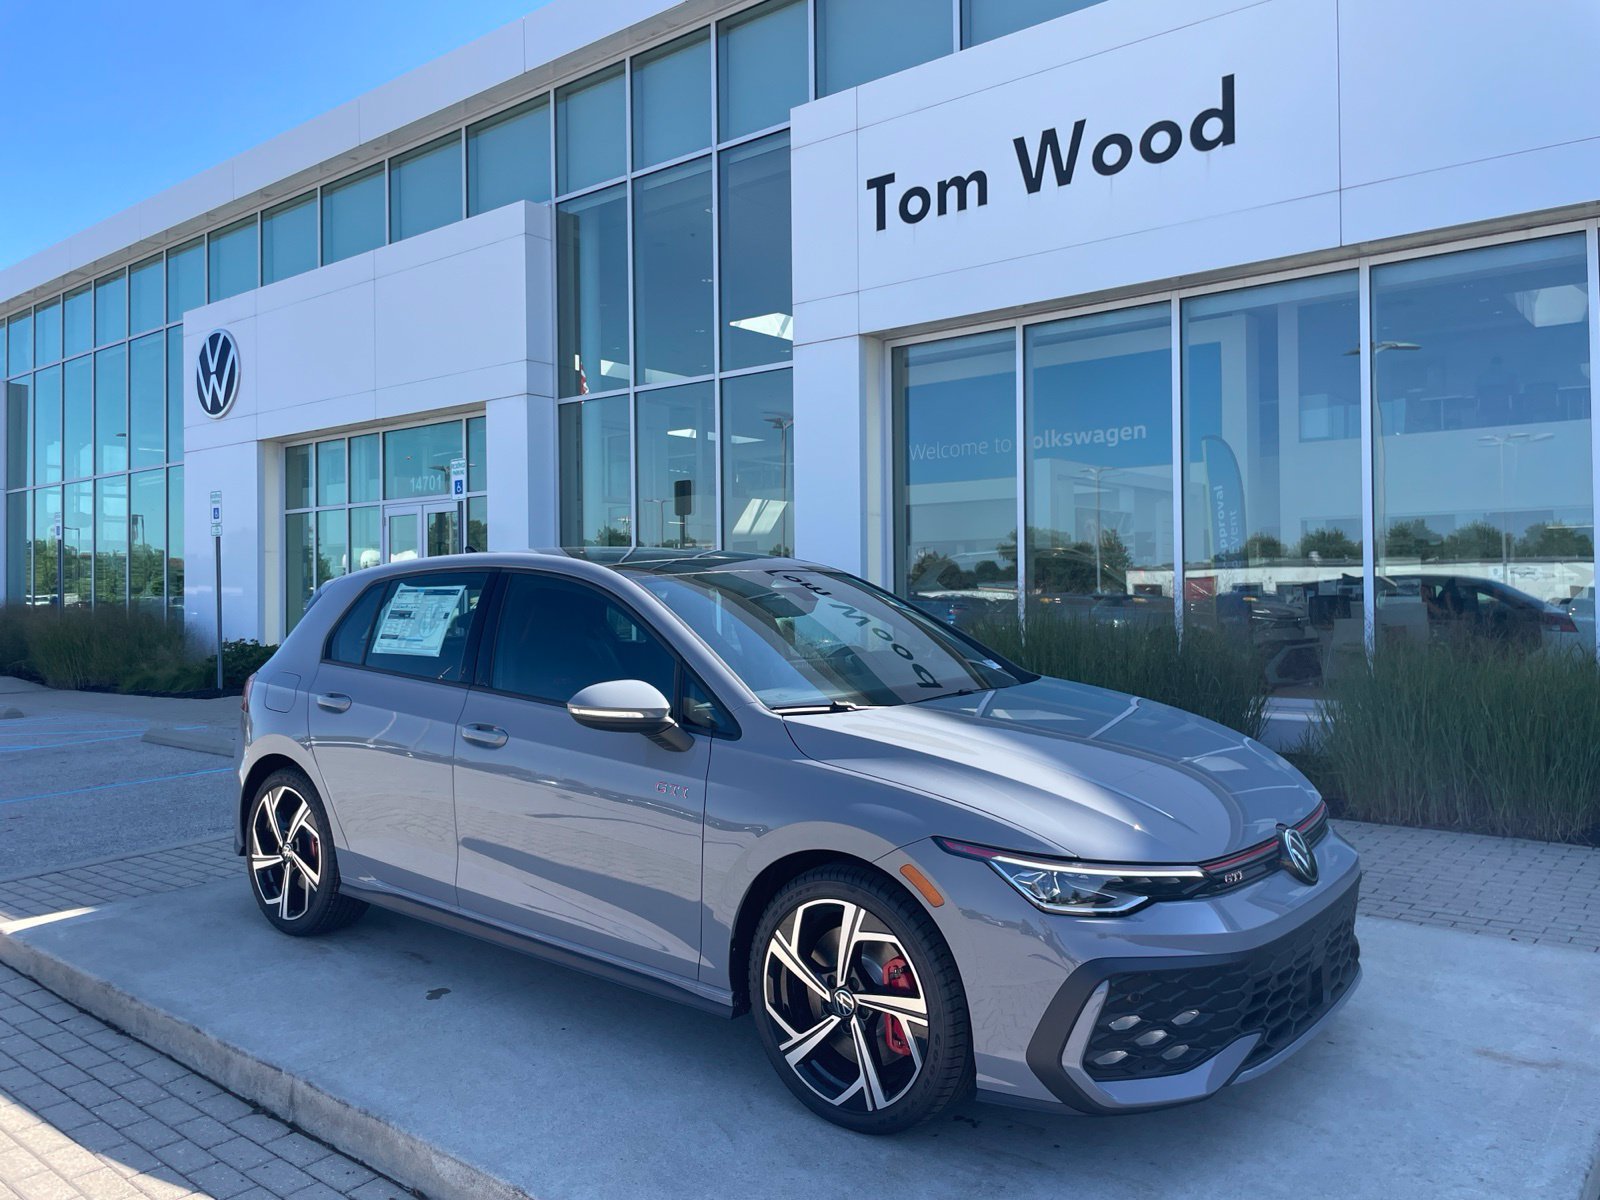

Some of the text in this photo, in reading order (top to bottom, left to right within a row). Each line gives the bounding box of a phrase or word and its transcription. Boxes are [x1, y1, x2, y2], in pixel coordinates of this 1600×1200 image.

[866, 73, 1235, 232] Tom Wood
[909, 424, 1147, 461] Welcome to olkswagen
[410, 474, 442, 493] 14701
[1229, 509, 1241, 554] Event
[655, 781, 689, 799] GTI
[1224, 870, 1243, 883] GTI
